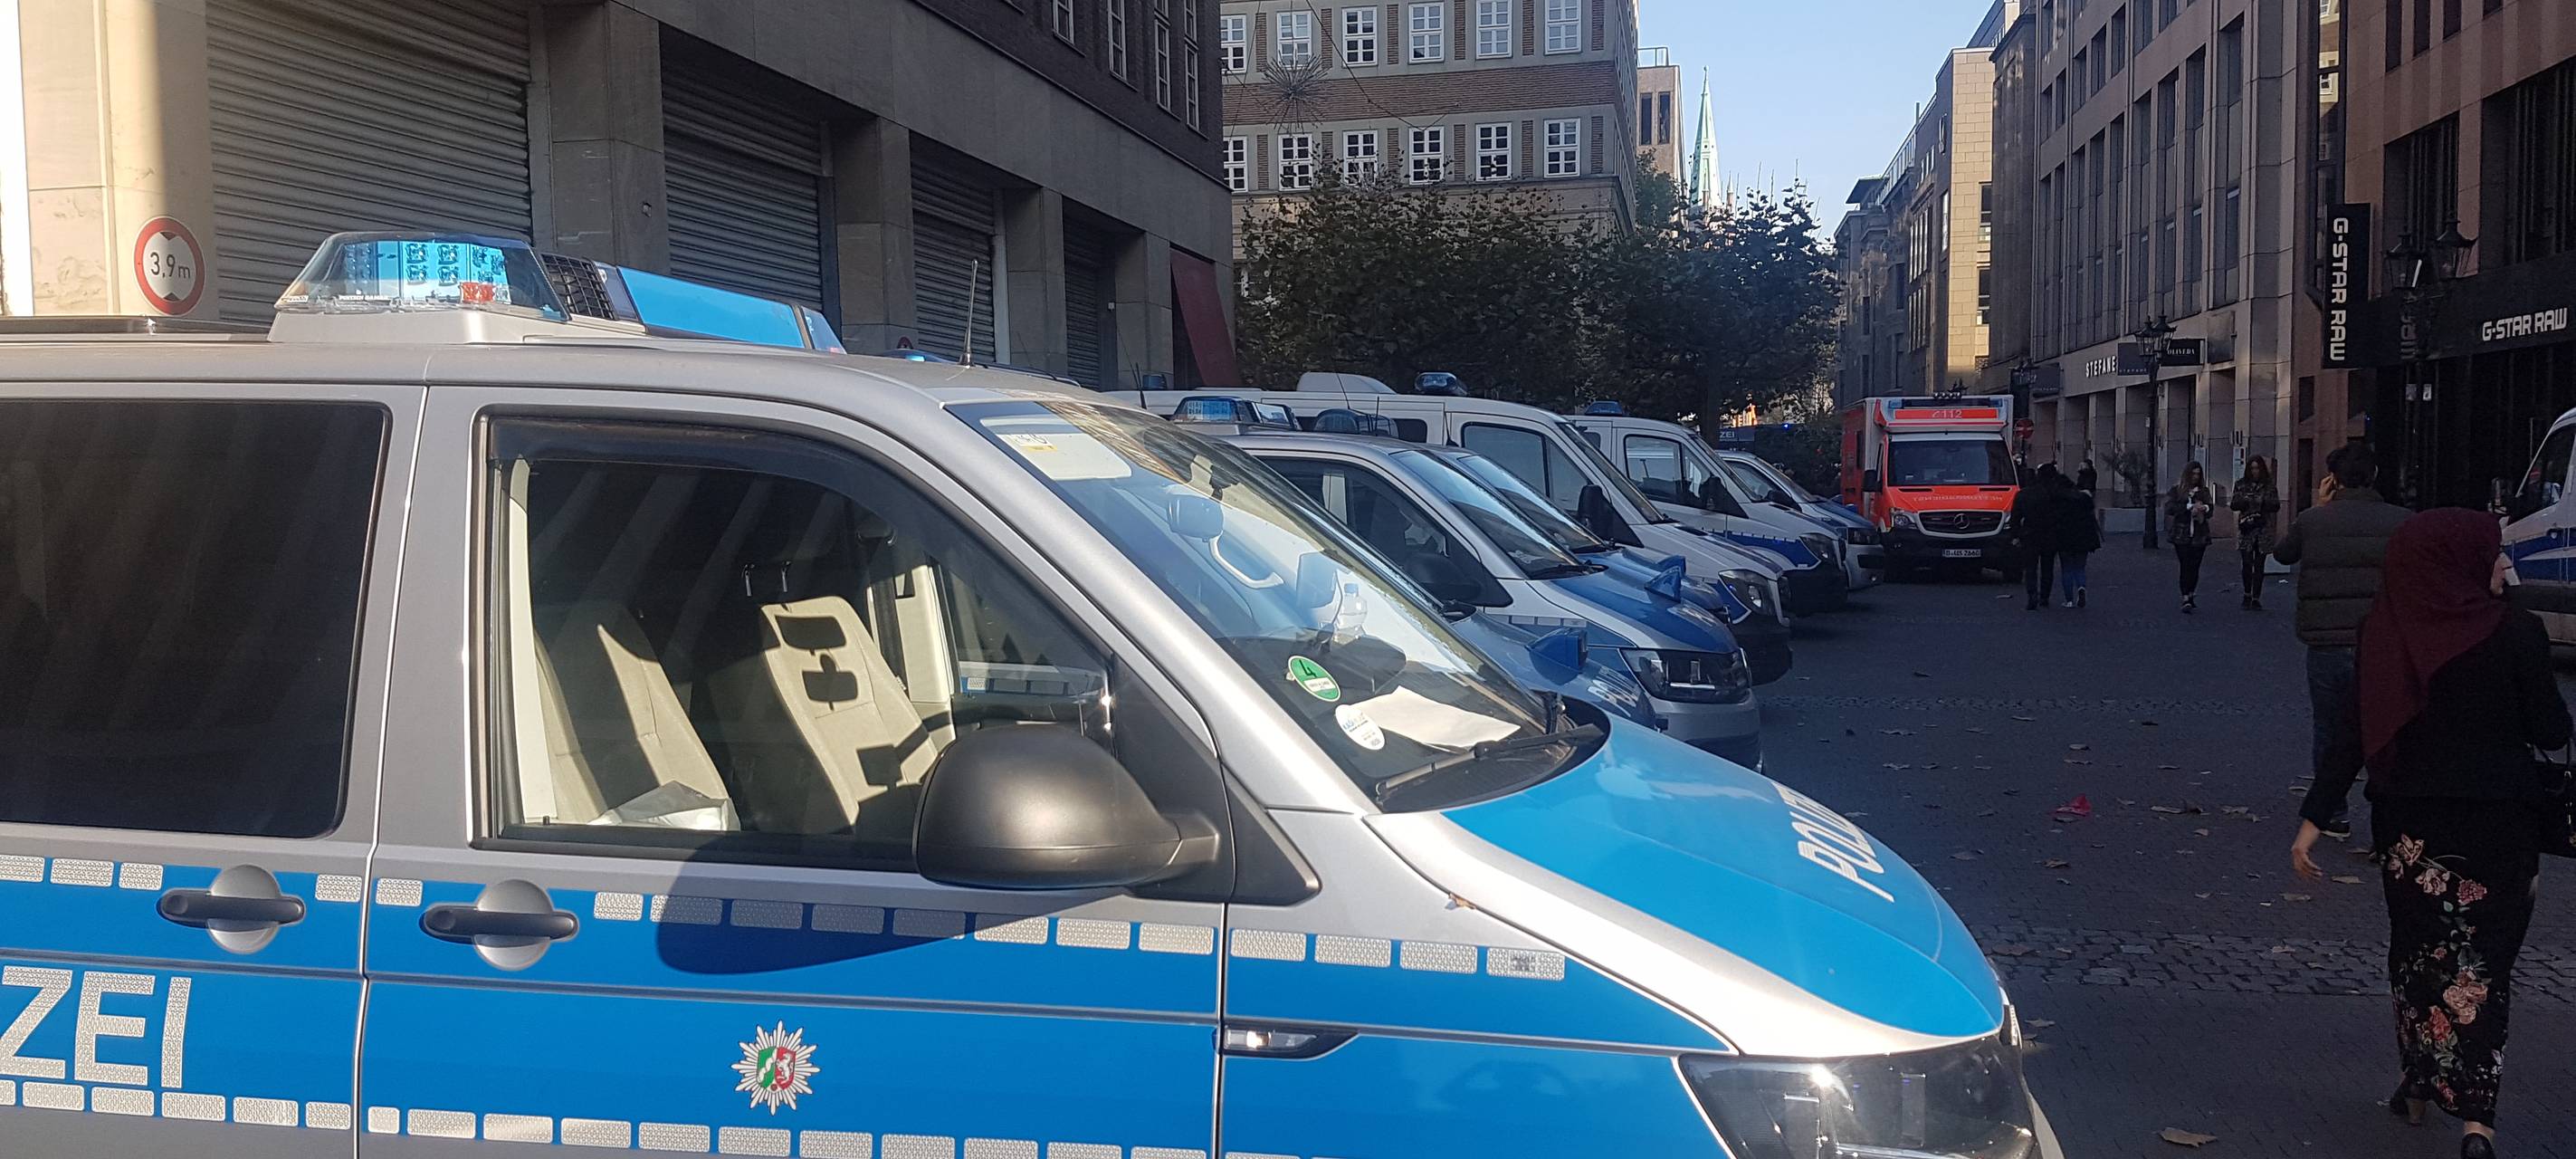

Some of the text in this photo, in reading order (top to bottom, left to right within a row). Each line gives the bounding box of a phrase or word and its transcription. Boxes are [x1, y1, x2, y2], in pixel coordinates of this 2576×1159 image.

[2329, 216, 2350, 361] G-STAR RAW
[2482, 307, 2568, 341] G-STAR RAW
[2085, 355, 2116, 378] STEFANE
[1942, 409, 1962, 418] 112
[0, 964, 192, 1089] ZEI
